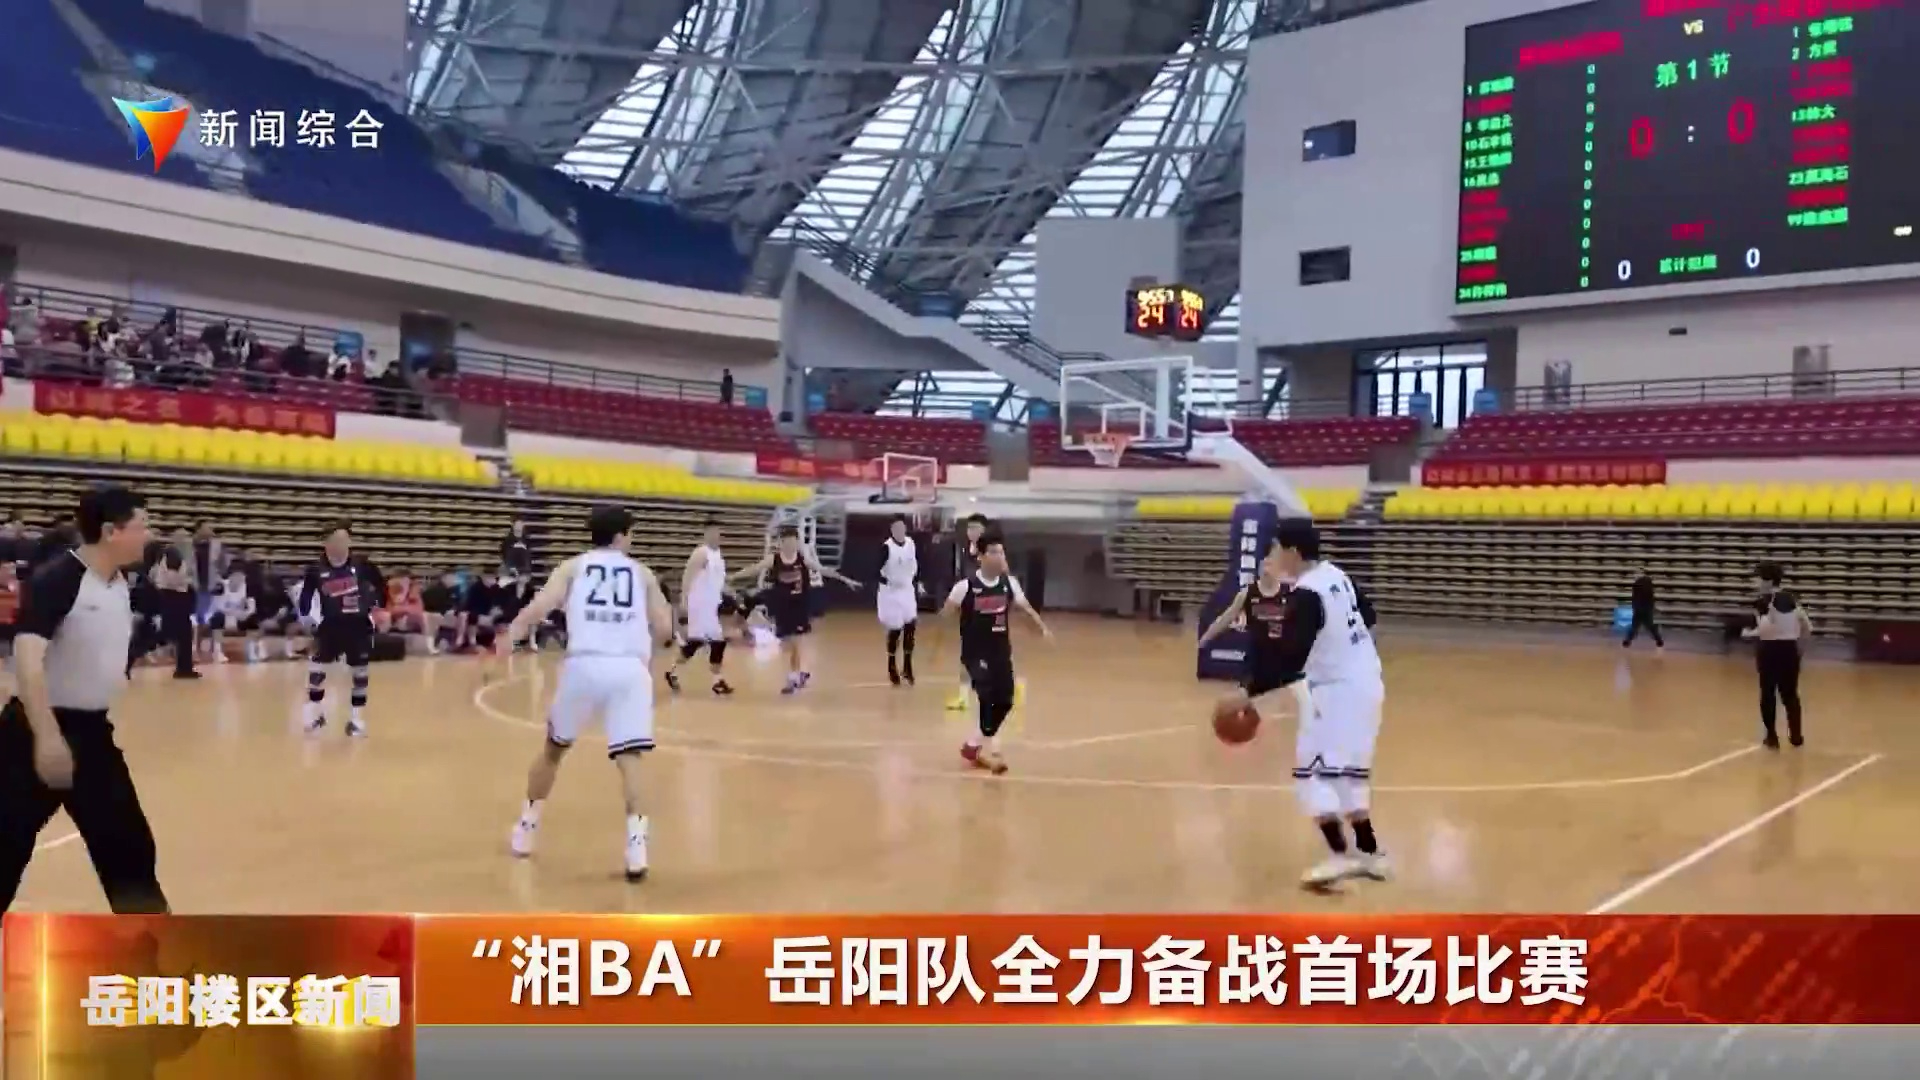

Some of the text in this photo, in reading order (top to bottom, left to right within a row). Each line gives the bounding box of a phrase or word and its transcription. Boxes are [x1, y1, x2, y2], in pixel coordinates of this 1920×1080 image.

[1655, 51, 1731, 88] 第 1 节
[1629, 116, 1654, 158] 0
[1727, 97, 1756, 144] 0
[1745, 247, 1761, 268] 0
[1617, 259, 1631, 281] 0
[1137, 305, 1164, 328] 24
[1181, 306, 1199, 329] 24
[585, 564, 634, 608] 20
